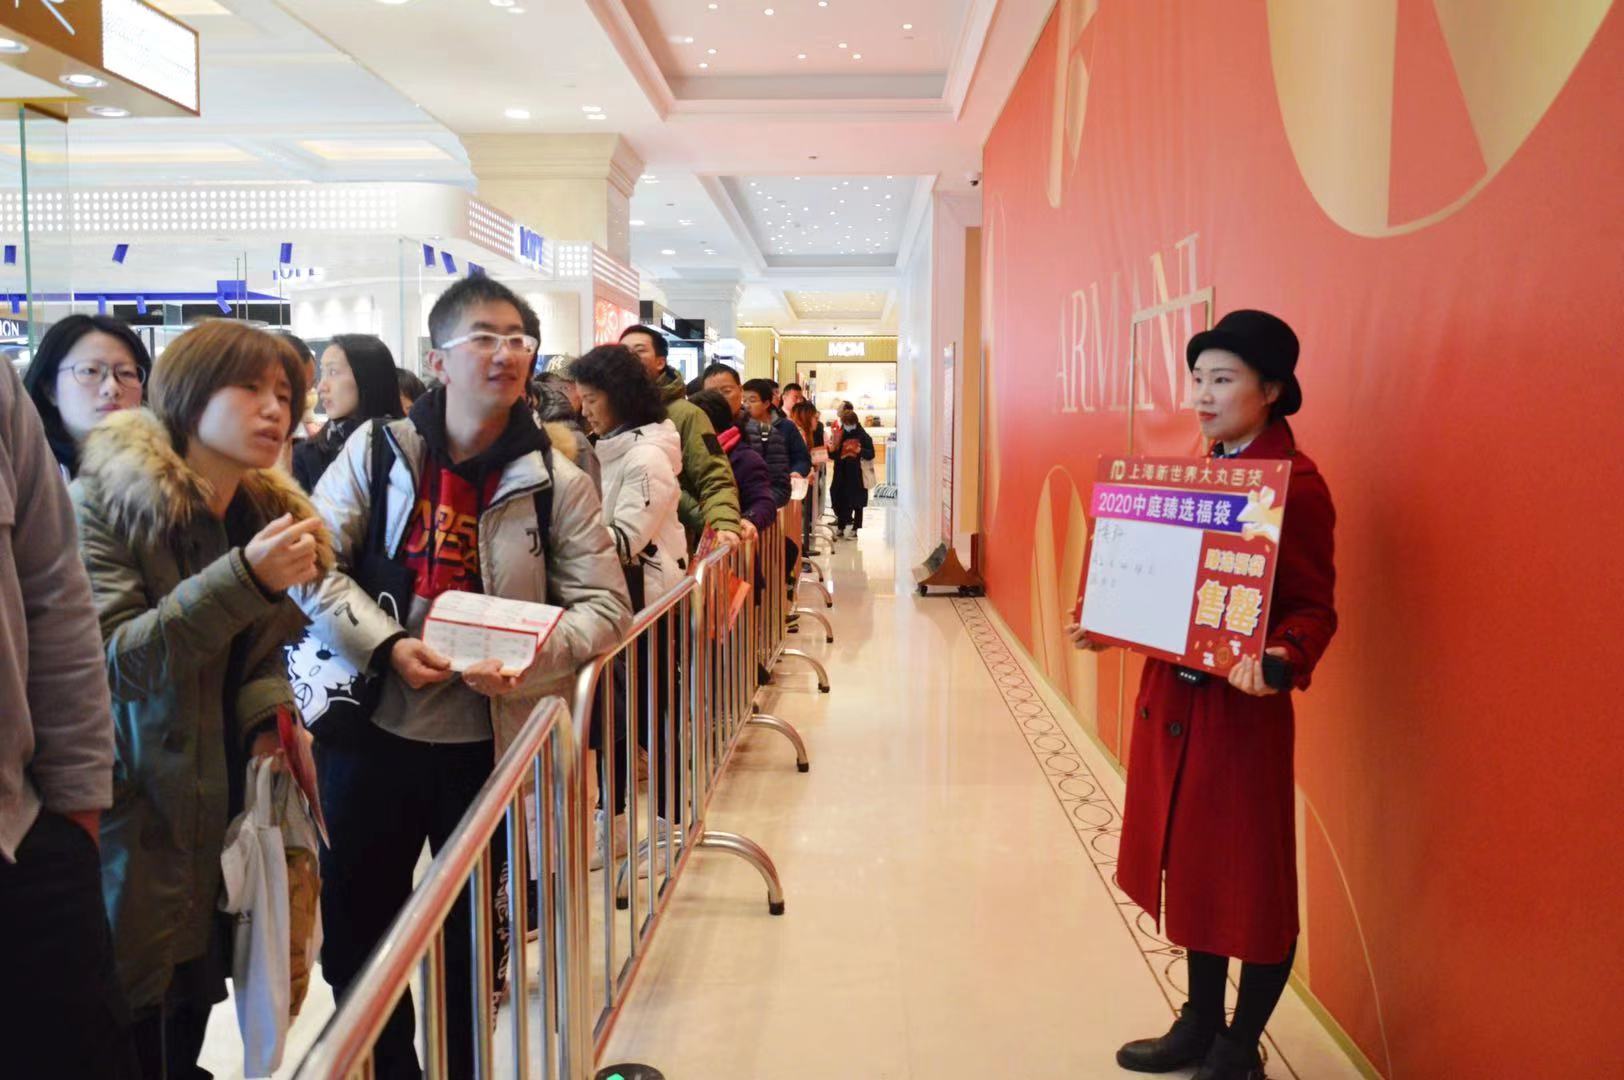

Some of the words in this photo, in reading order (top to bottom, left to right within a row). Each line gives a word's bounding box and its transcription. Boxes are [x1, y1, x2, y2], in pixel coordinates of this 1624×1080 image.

[1055, 232, 1199, 413] ARMANI
[1098, 491, 1233, 526] 2020中庭臻选福袋
[1194, 578, 1264, 637] 售罄
